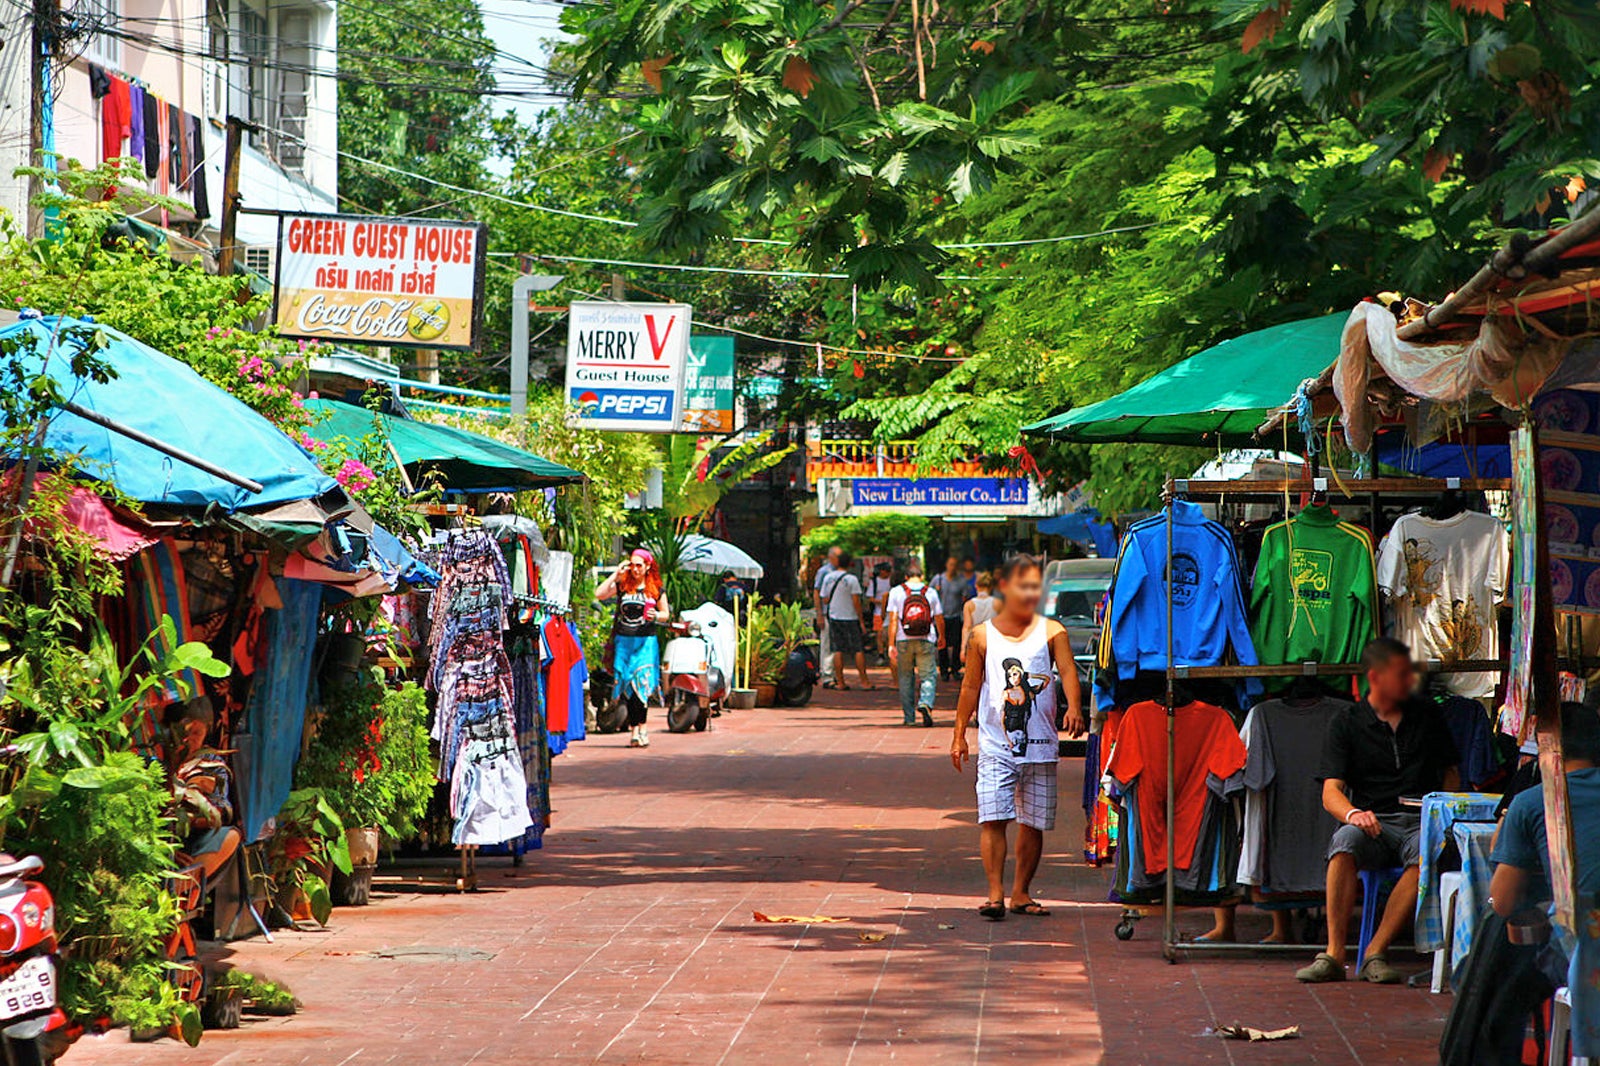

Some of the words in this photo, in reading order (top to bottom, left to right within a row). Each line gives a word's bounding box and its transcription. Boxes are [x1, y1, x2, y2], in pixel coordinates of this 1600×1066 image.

[288, 218, 346, 256] GREEN
[353, 223, 408, 260] GUEST
[414, 226, 473, 264] HOUSE
[315, 261, 348, 290] กรีน
[355, 264, 396, 293] เกสท์
[297, 294, 414, 337] Coca-Cola
[577, 330, 640, 360] MERRY
[644, 314, 676, 361] V
[576, 368, 618, 382] Guest
[625, 371, 670, 383] House
[600, 394, 667, 414] PEPSI
[858, 487, 888, 502] New
[892, 487, 926, 505] Light
[929, 487, 968, 502] Tailor
